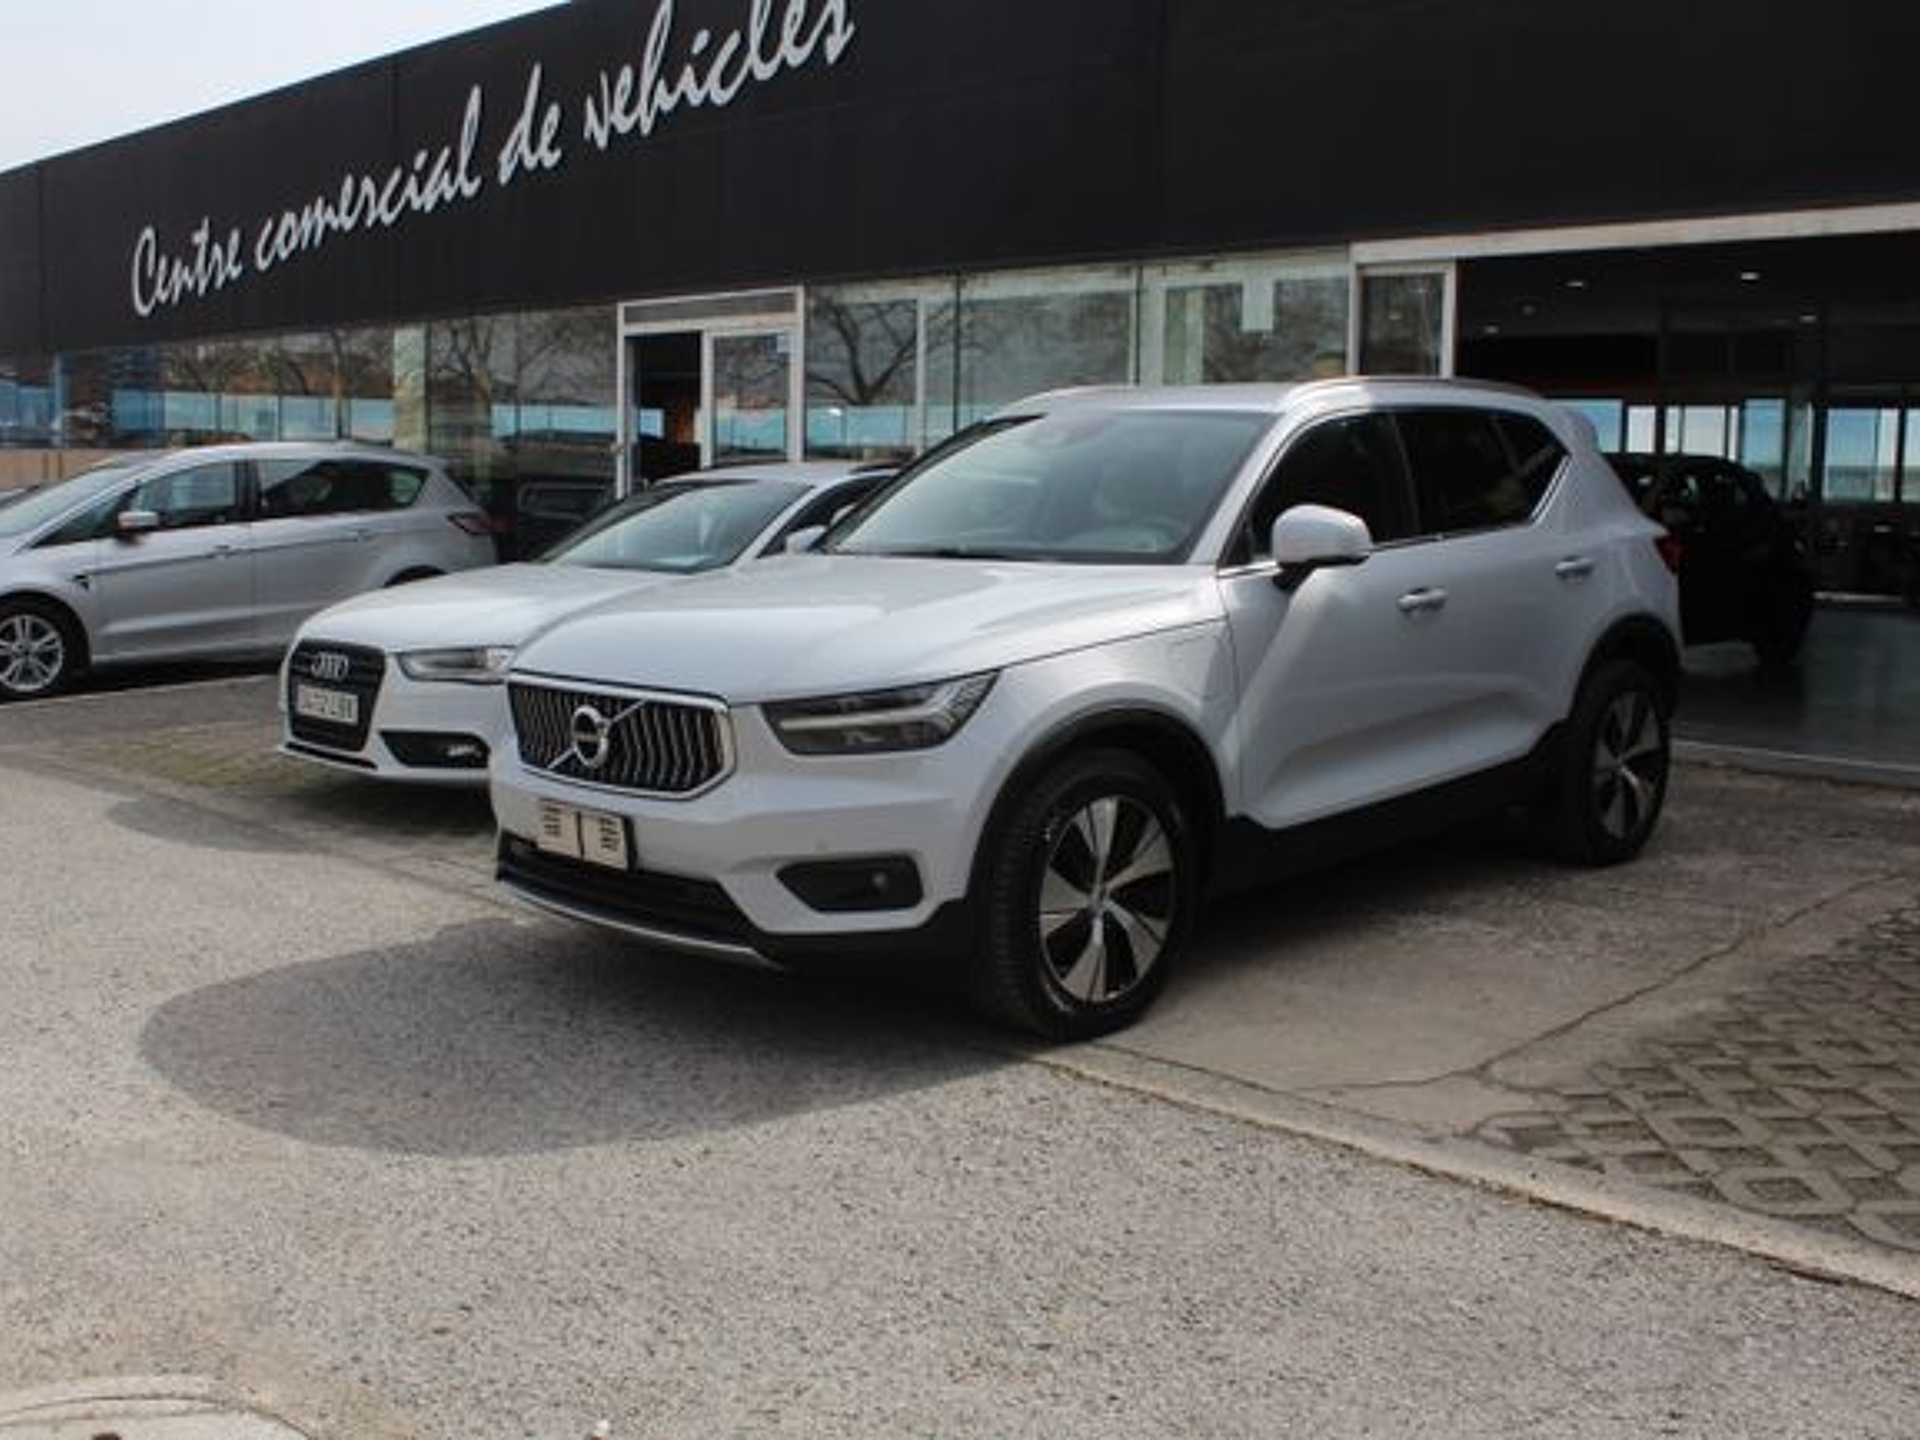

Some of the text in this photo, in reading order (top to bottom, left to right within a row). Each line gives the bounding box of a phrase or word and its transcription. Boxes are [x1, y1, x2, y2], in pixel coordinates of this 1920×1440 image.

[132, 0, 855, 316] Centre comercial de vehicles
